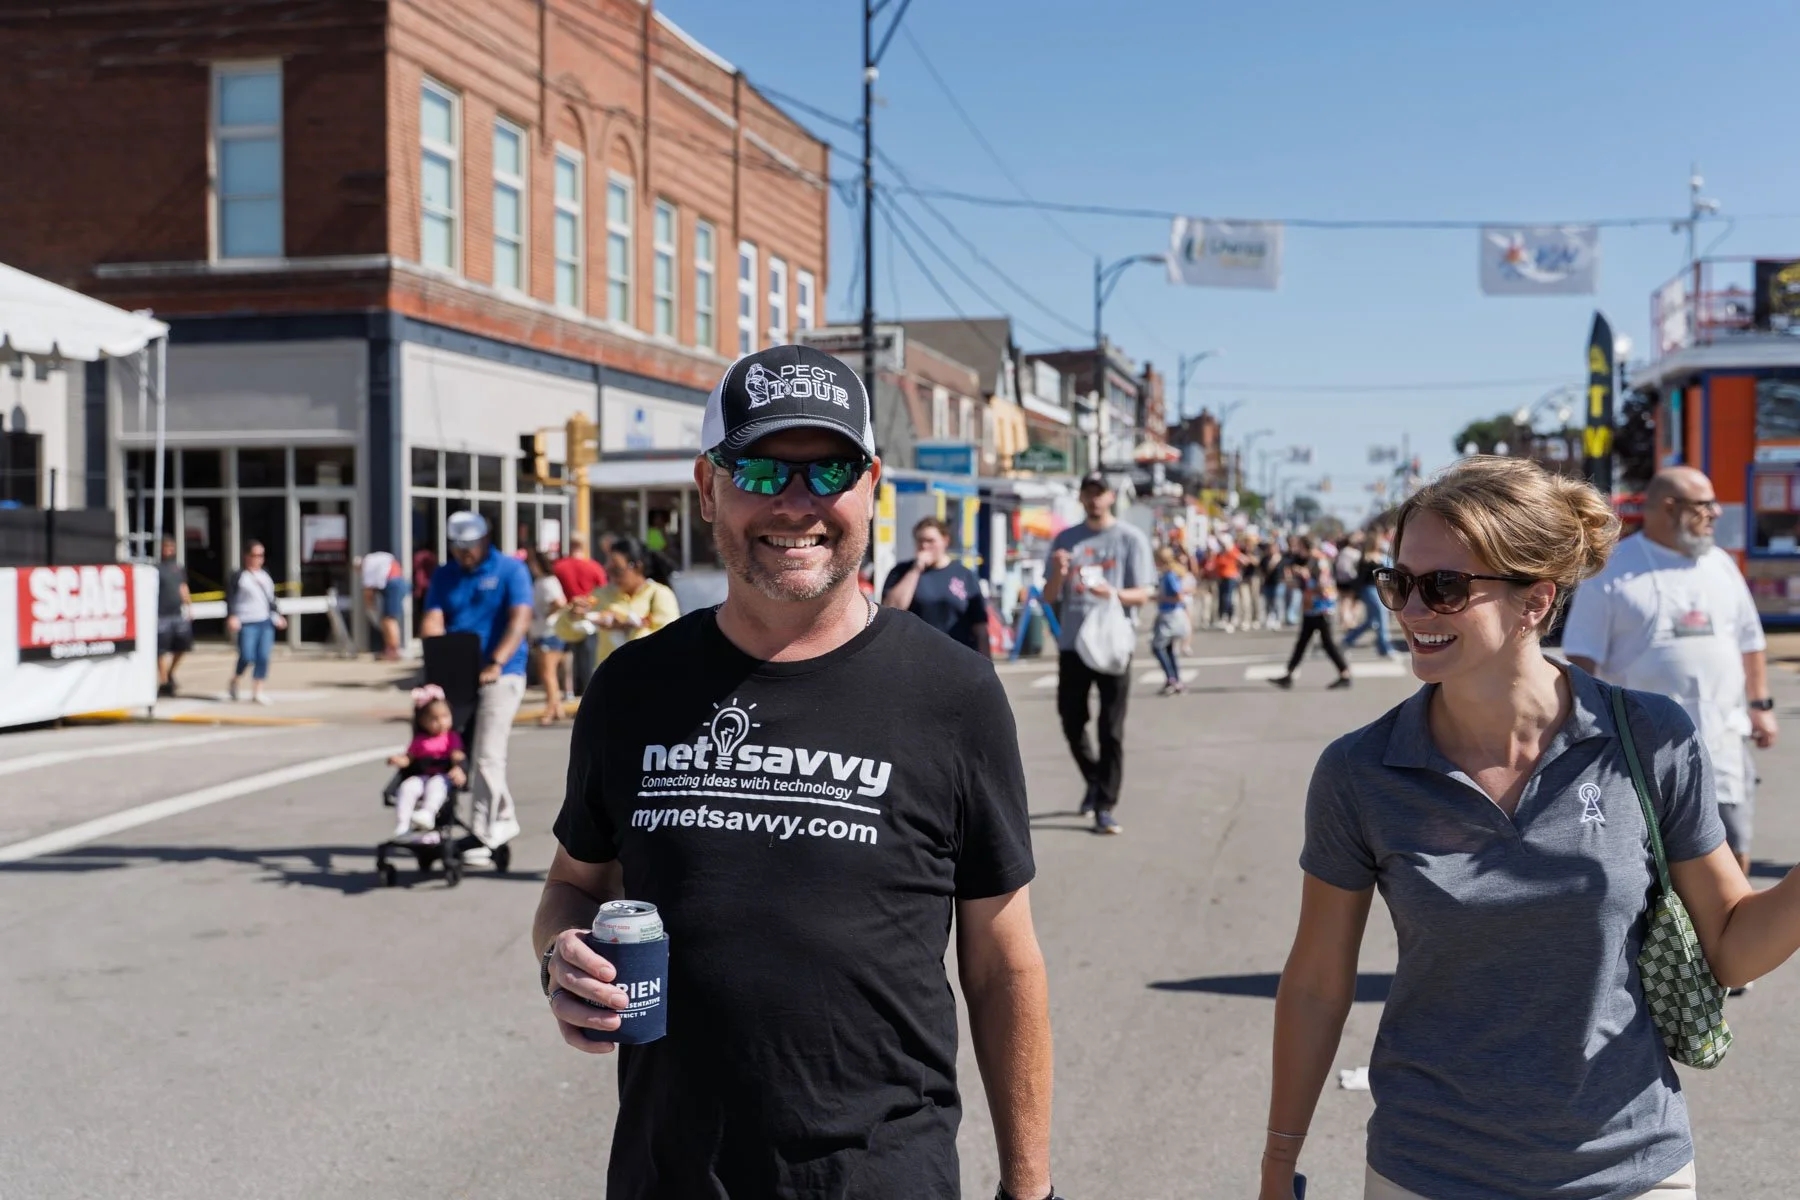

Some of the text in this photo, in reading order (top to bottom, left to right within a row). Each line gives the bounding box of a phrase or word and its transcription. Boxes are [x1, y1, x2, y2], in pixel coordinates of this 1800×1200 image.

[29, 565, 127, 621] SCAG
[641, 773, 853, 800] Connecting ideas with technology
[642, 735, 893, 798] net savvy
[631, 804, 879, 845] mynetsavvy.com
